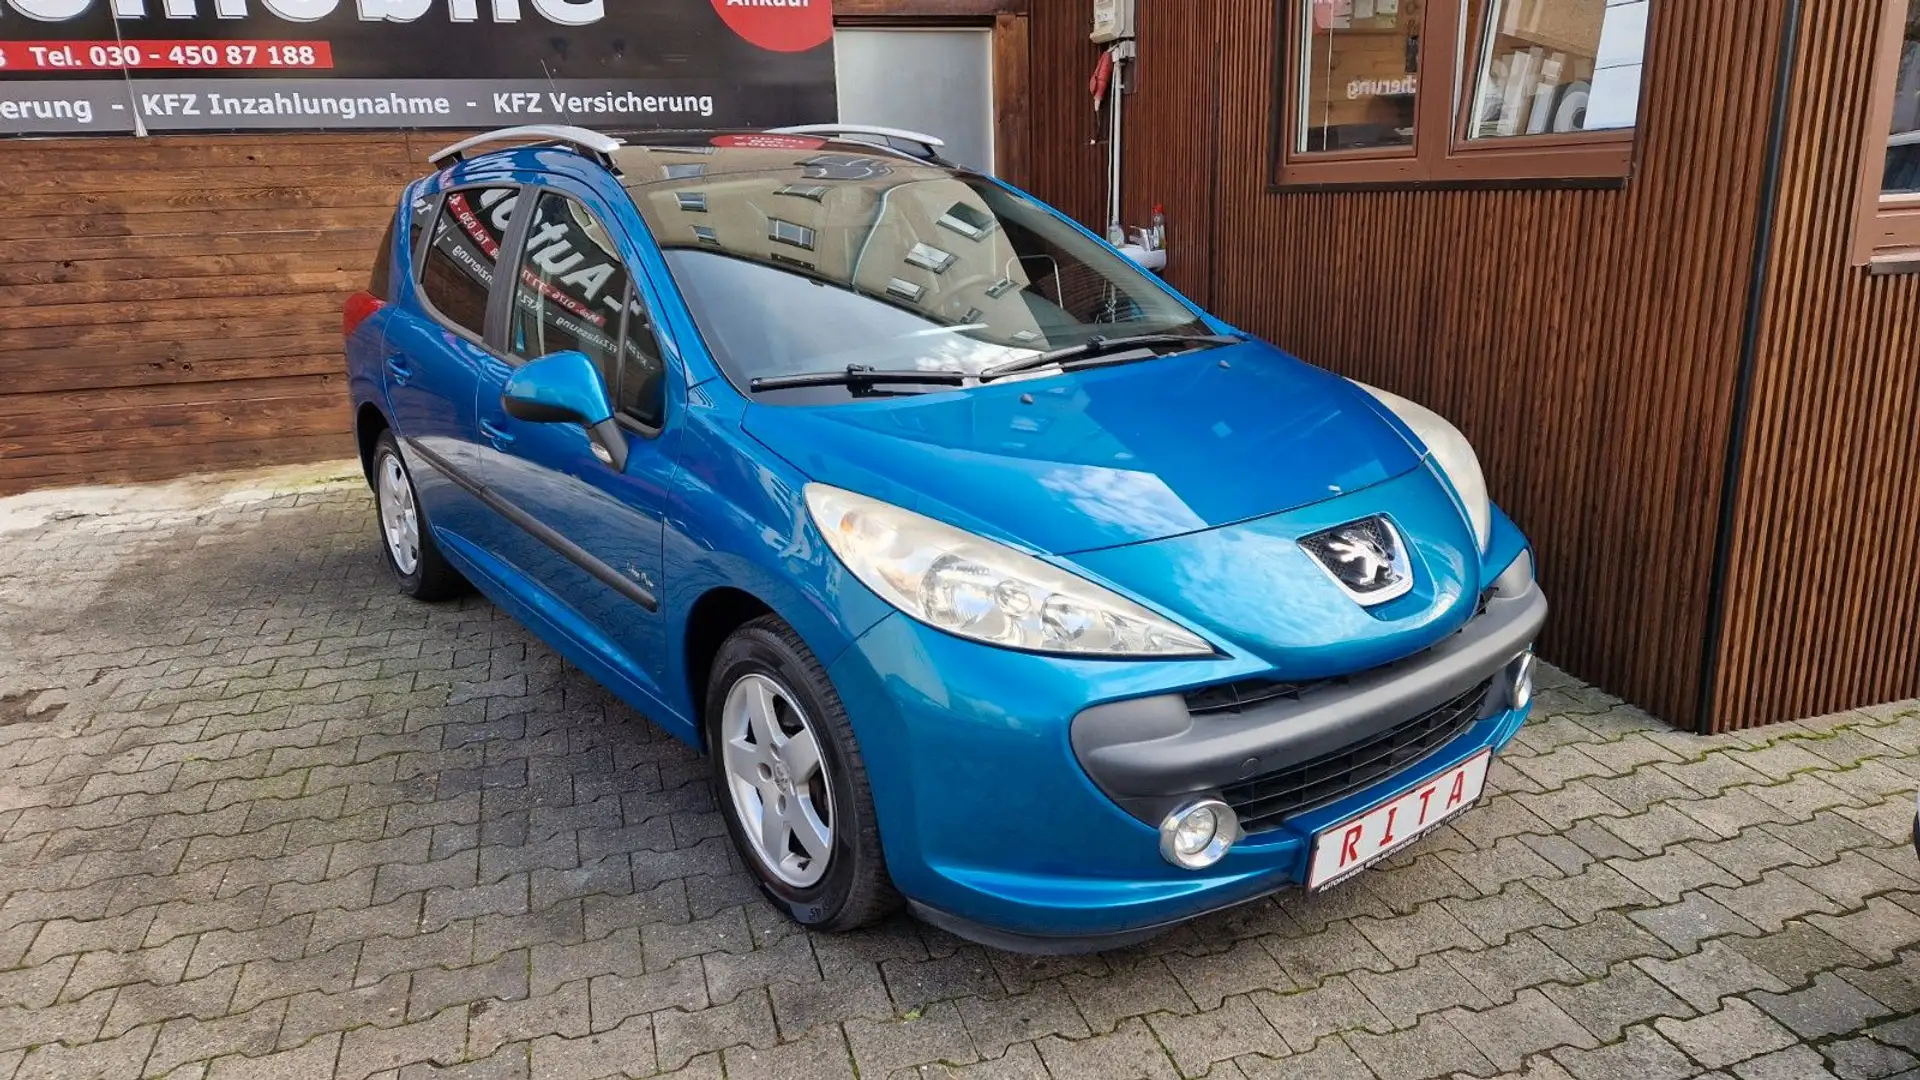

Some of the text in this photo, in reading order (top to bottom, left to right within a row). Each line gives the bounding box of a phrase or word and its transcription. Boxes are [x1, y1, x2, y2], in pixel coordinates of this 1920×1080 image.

[29, 45, 82, 67] Tel.
[89, 45, 141, 66] 030
[168, 44, 218, 66] 450
[225, 44, 257, 66] 87
[267, 44, 316, 66] 188
[142, 93, 201, 116] KFZ
[207, 92, 450, 120] Inzahlungnahme
[493, 92, 543, 114] KFZ
[548, 90, 713, 117] Versicherung
[1339, 770, 1465, 868] RITA
